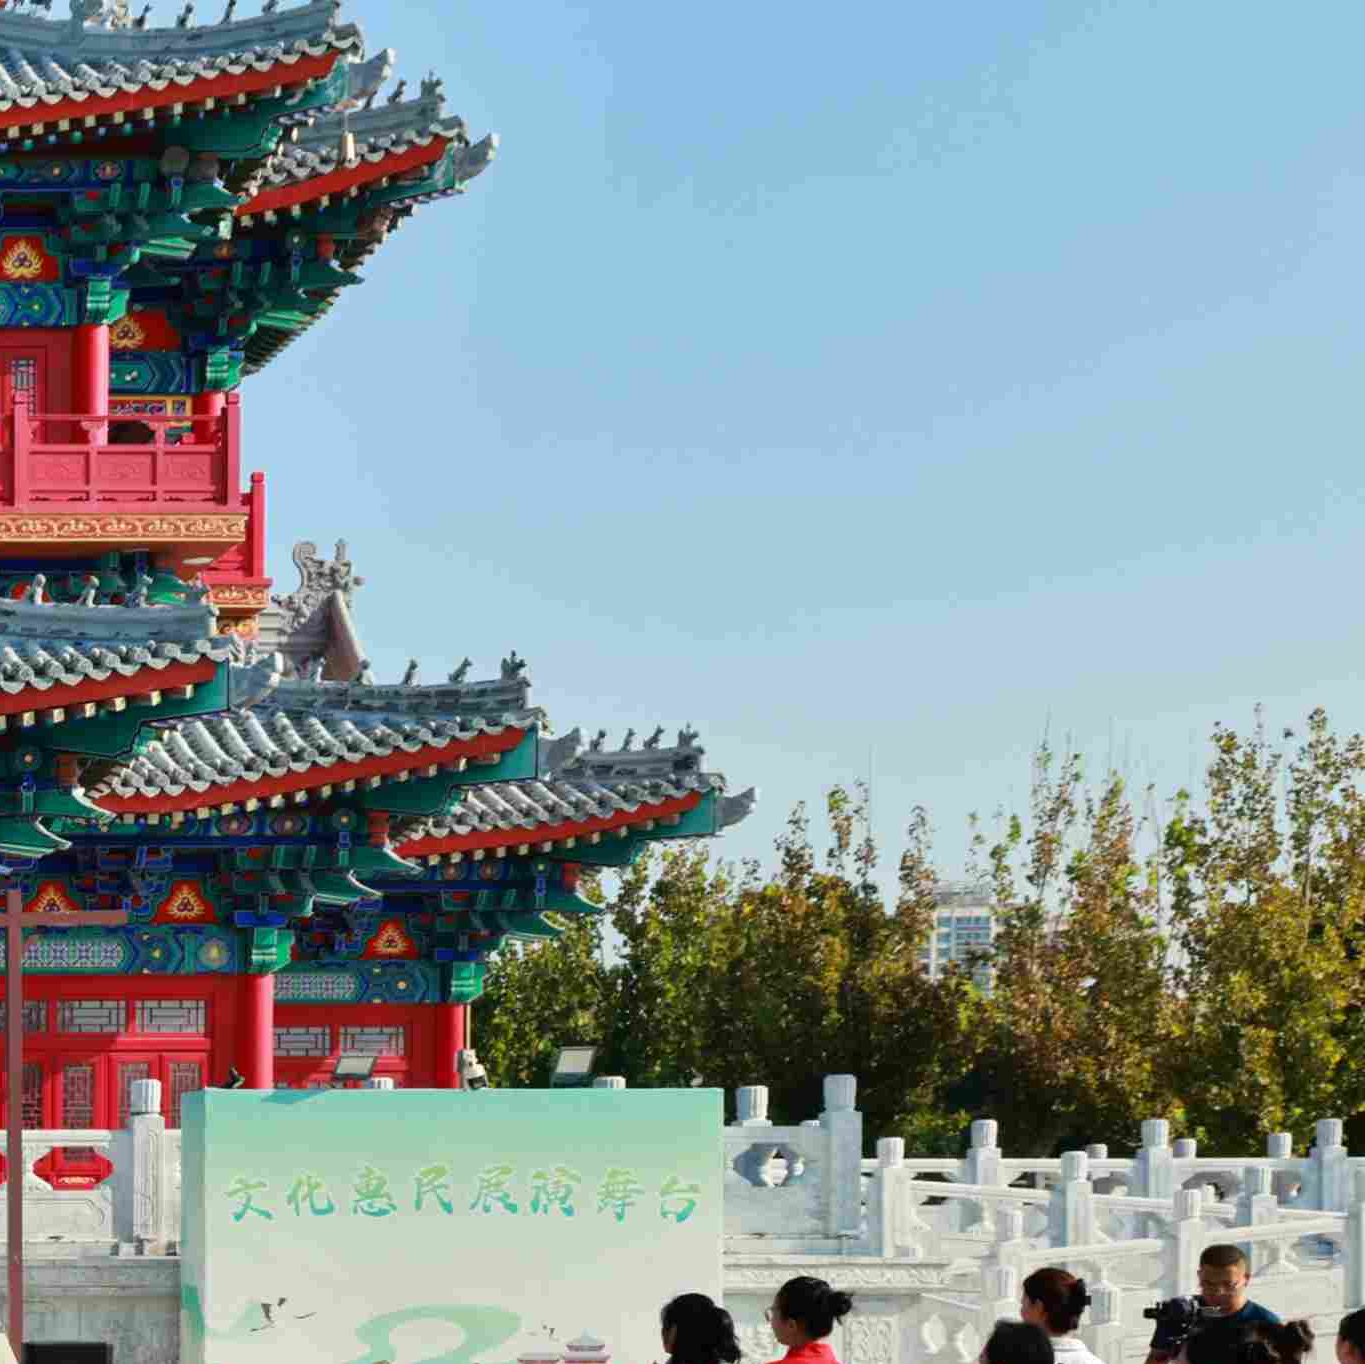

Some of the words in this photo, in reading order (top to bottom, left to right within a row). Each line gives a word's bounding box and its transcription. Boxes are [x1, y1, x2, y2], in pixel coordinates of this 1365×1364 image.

[223, 1164, 701, 1223] 文化惠民展演舞台
